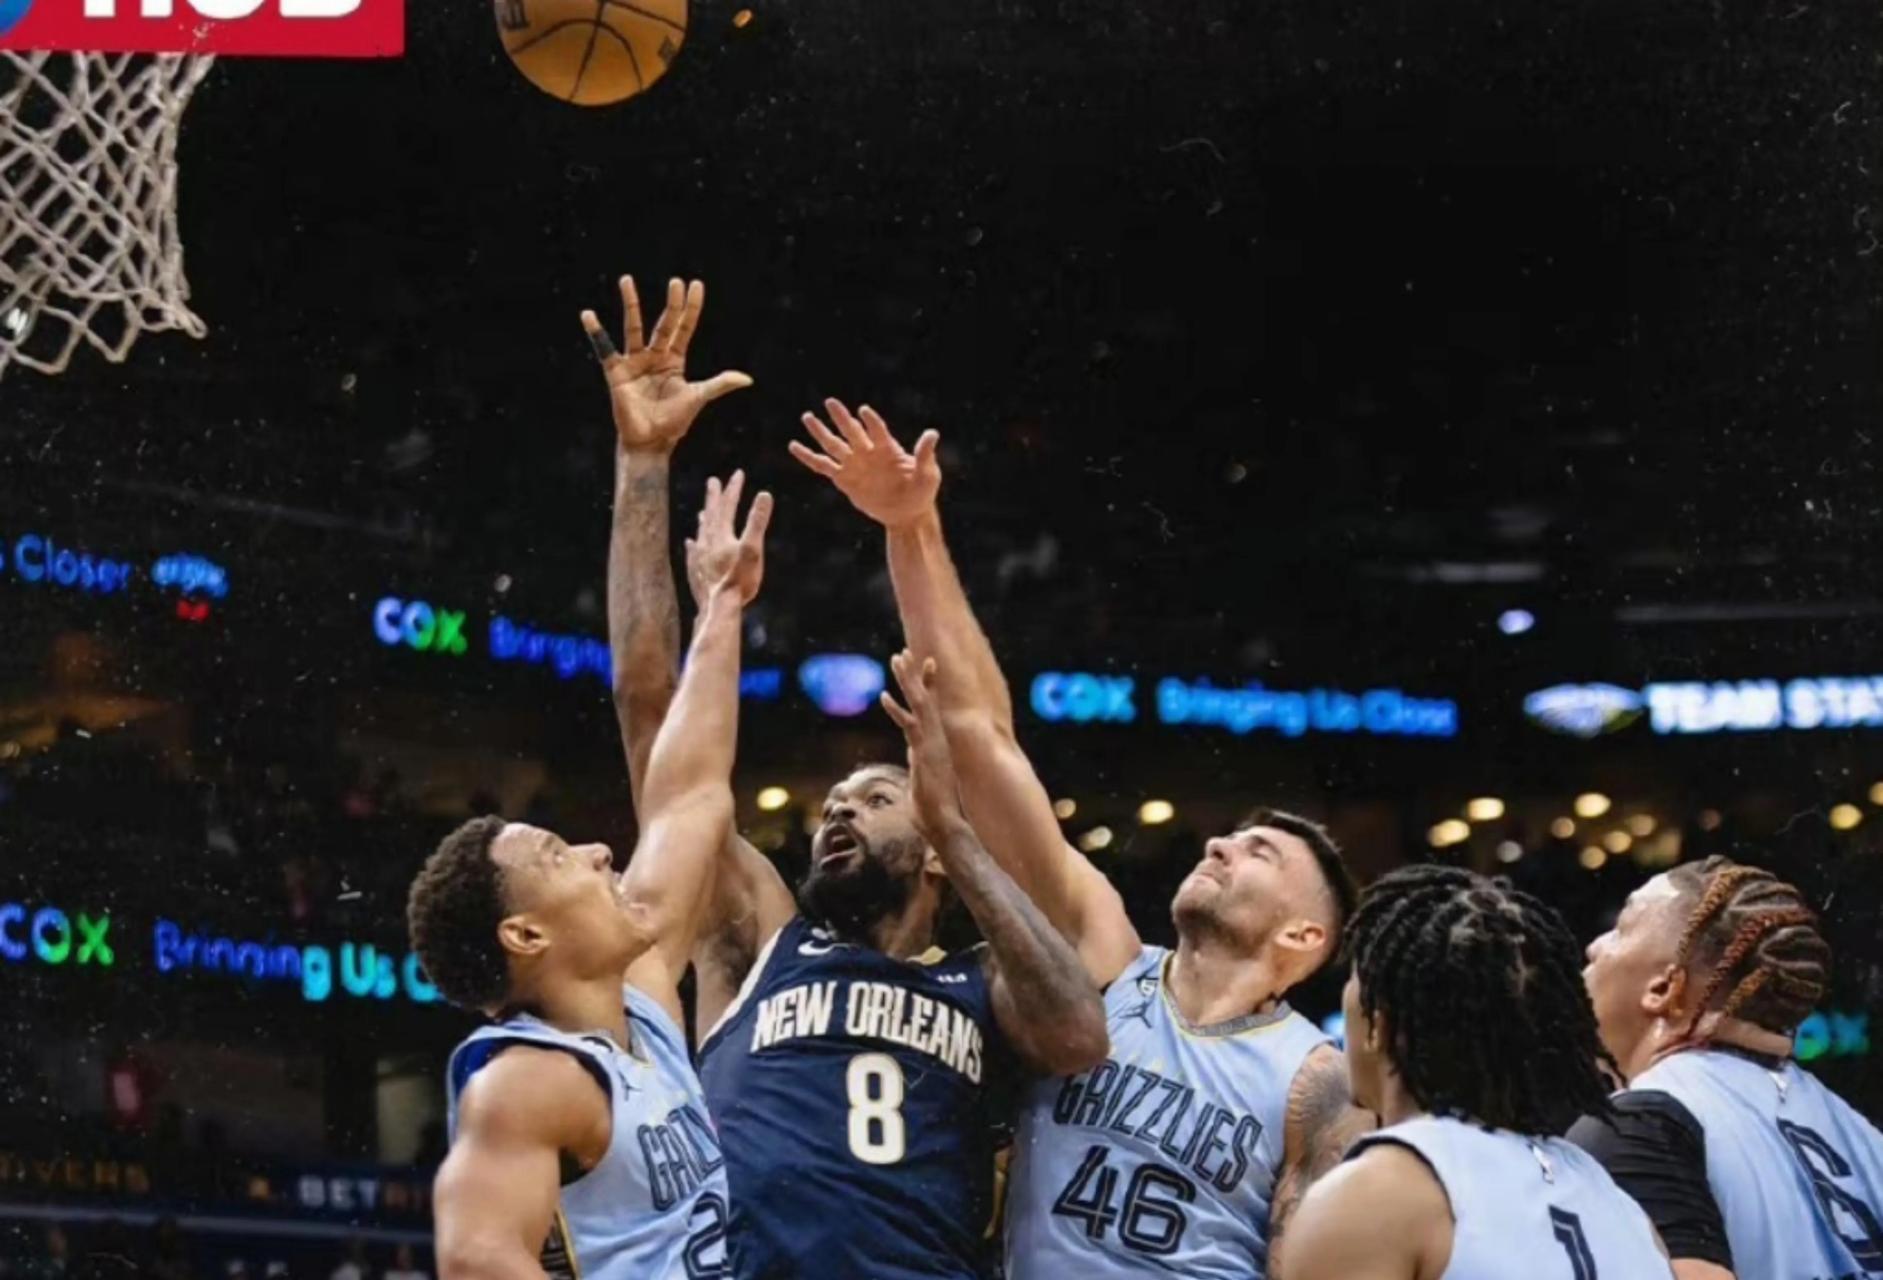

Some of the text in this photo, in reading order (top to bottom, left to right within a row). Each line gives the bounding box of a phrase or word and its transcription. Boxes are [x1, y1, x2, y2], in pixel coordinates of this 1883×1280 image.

[373, 597, 468, 654] COX
[1030, 671, 1136, 722] COX
[1648, 679, 1780, 733] TEAM
[0, 903, 113, 965] COX
[341, 942, 396, 998] Us
[750, 980, 983, 1085] NEW ORLEANS
[846, 1052, 905, 1164] 8
[1053, 1058, 1264, 1193] GRIZZLIES
[1052, 1144, 1197, 1255] 46
